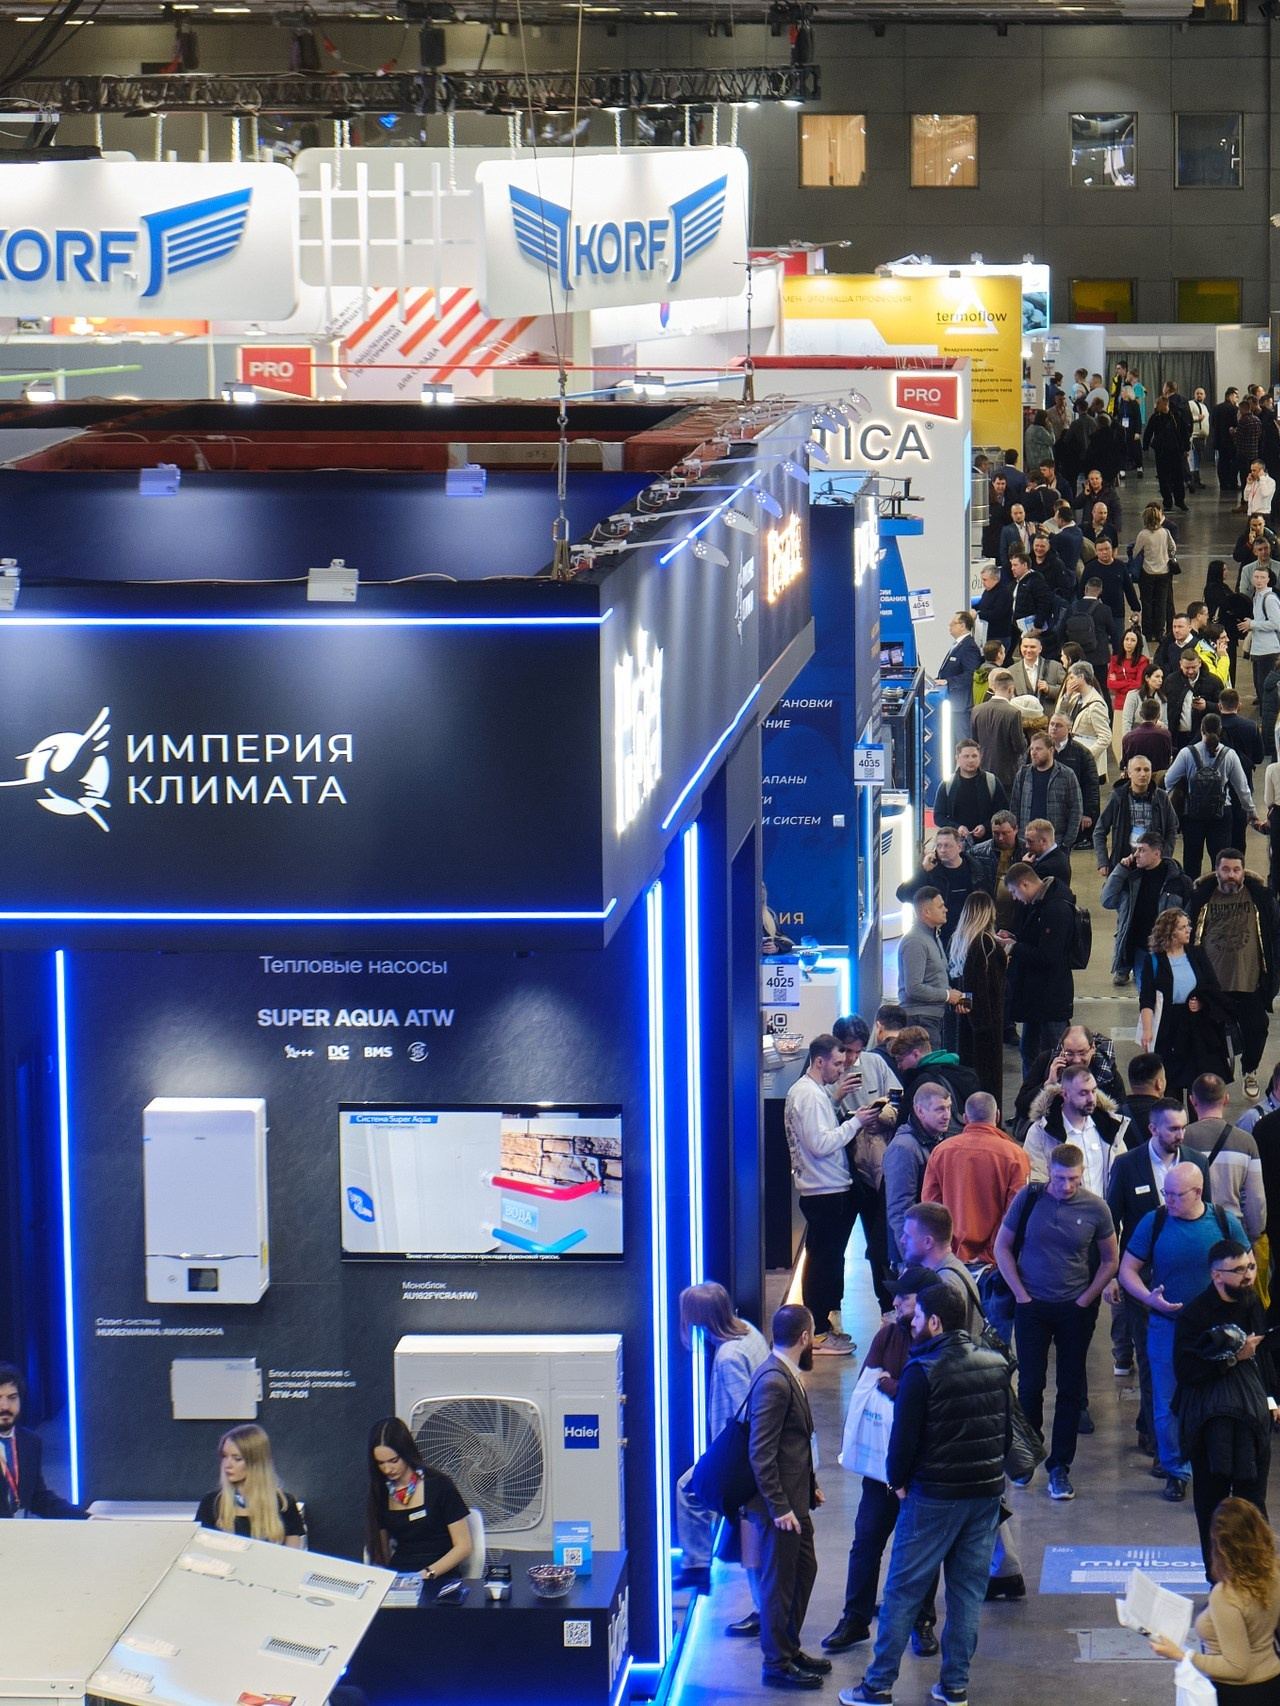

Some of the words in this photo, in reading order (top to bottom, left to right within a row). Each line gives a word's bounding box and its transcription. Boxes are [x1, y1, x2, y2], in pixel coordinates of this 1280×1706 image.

[575, 219, 670, 276] KORF
[0, 228, 138, 282] ORF
[936, 310, 1008, 322] termoflow
[248, 361, 295, 378] PRO
[903, 388, 941, 403] PRO
[913, 601, 930, 609] 4045
[126, 733, 354, 763] ИМПЕРИЯ
[866, 751, 872, 759] E
[761, 775, 808, 784] АПАНЫ
[127, 775, 348, 804] КЛИМАТА
[773, 816, 822, 825] СИСТЕМ
[258, 955, 363, 975] Тепловые
[368, 959, 448, 975] насосы
[776, 966, 785, 977] E
[766, 977, 794, 988] 4025
[257, 1008, 330, 1027] SUPER
[334, 1008, 400, 1027] AQUA
[404, 1008, 455, 1027] ATW
[327, 1044, 350, 1057] DC
[364, 1046, 393, 1058] BMS
[389, 1115, 411, 1123] Super
[412, 1115, 431, 1123] Aqua
[504, 1206, 532, 1223] ВОДА
[402, 1280, 447, 1290] Моноблок
[268, 1369, 290, 1378] Блок
[291, 1370, 343, 1379] сопряжения
[268, 1379, 310, 1388] системой
[564, 1425, 599, 1438] Haier
[1079, 1559, 1205, 1568] minibox
